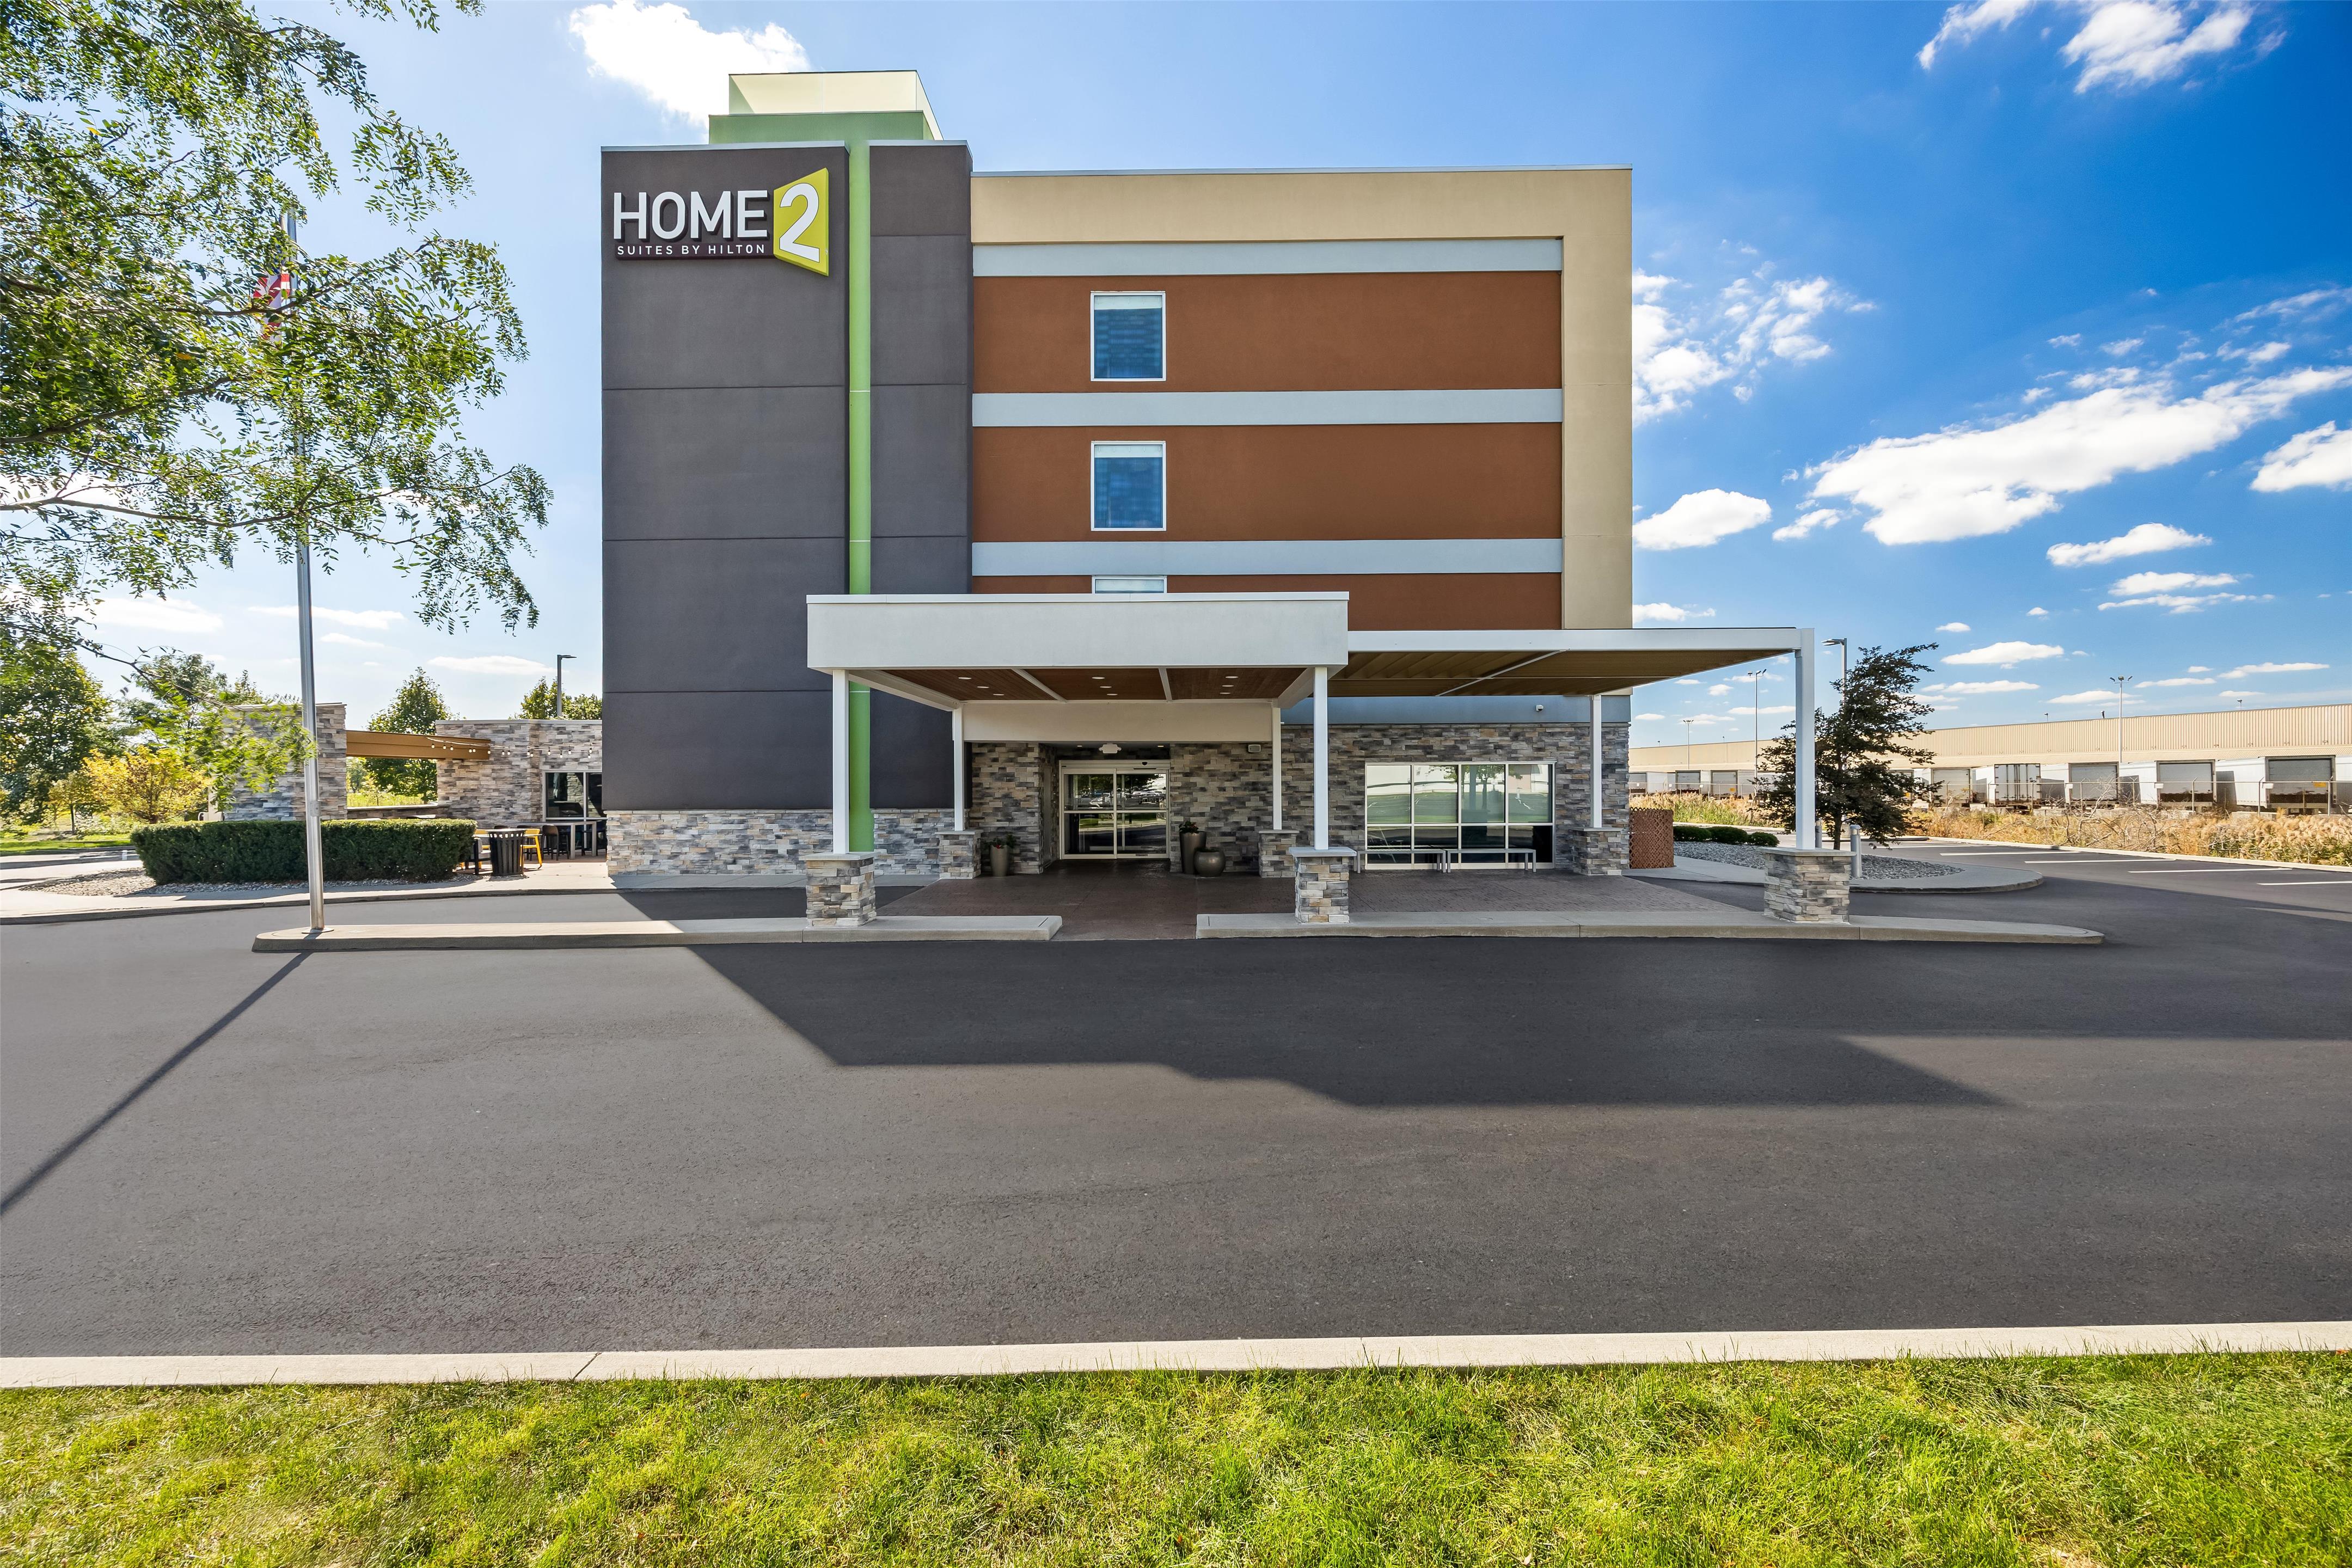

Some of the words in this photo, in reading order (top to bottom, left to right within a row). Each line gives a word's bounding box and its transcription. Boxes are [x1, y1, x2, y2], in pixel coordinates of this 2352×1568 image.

[614, 190, 768, 239] HOME
[780, 182, 820, 263] 2
[617, 245, 673, 255] SUITES
[682, 244, 700, 255] BY
[708, 243, 765, 254] HILTON
